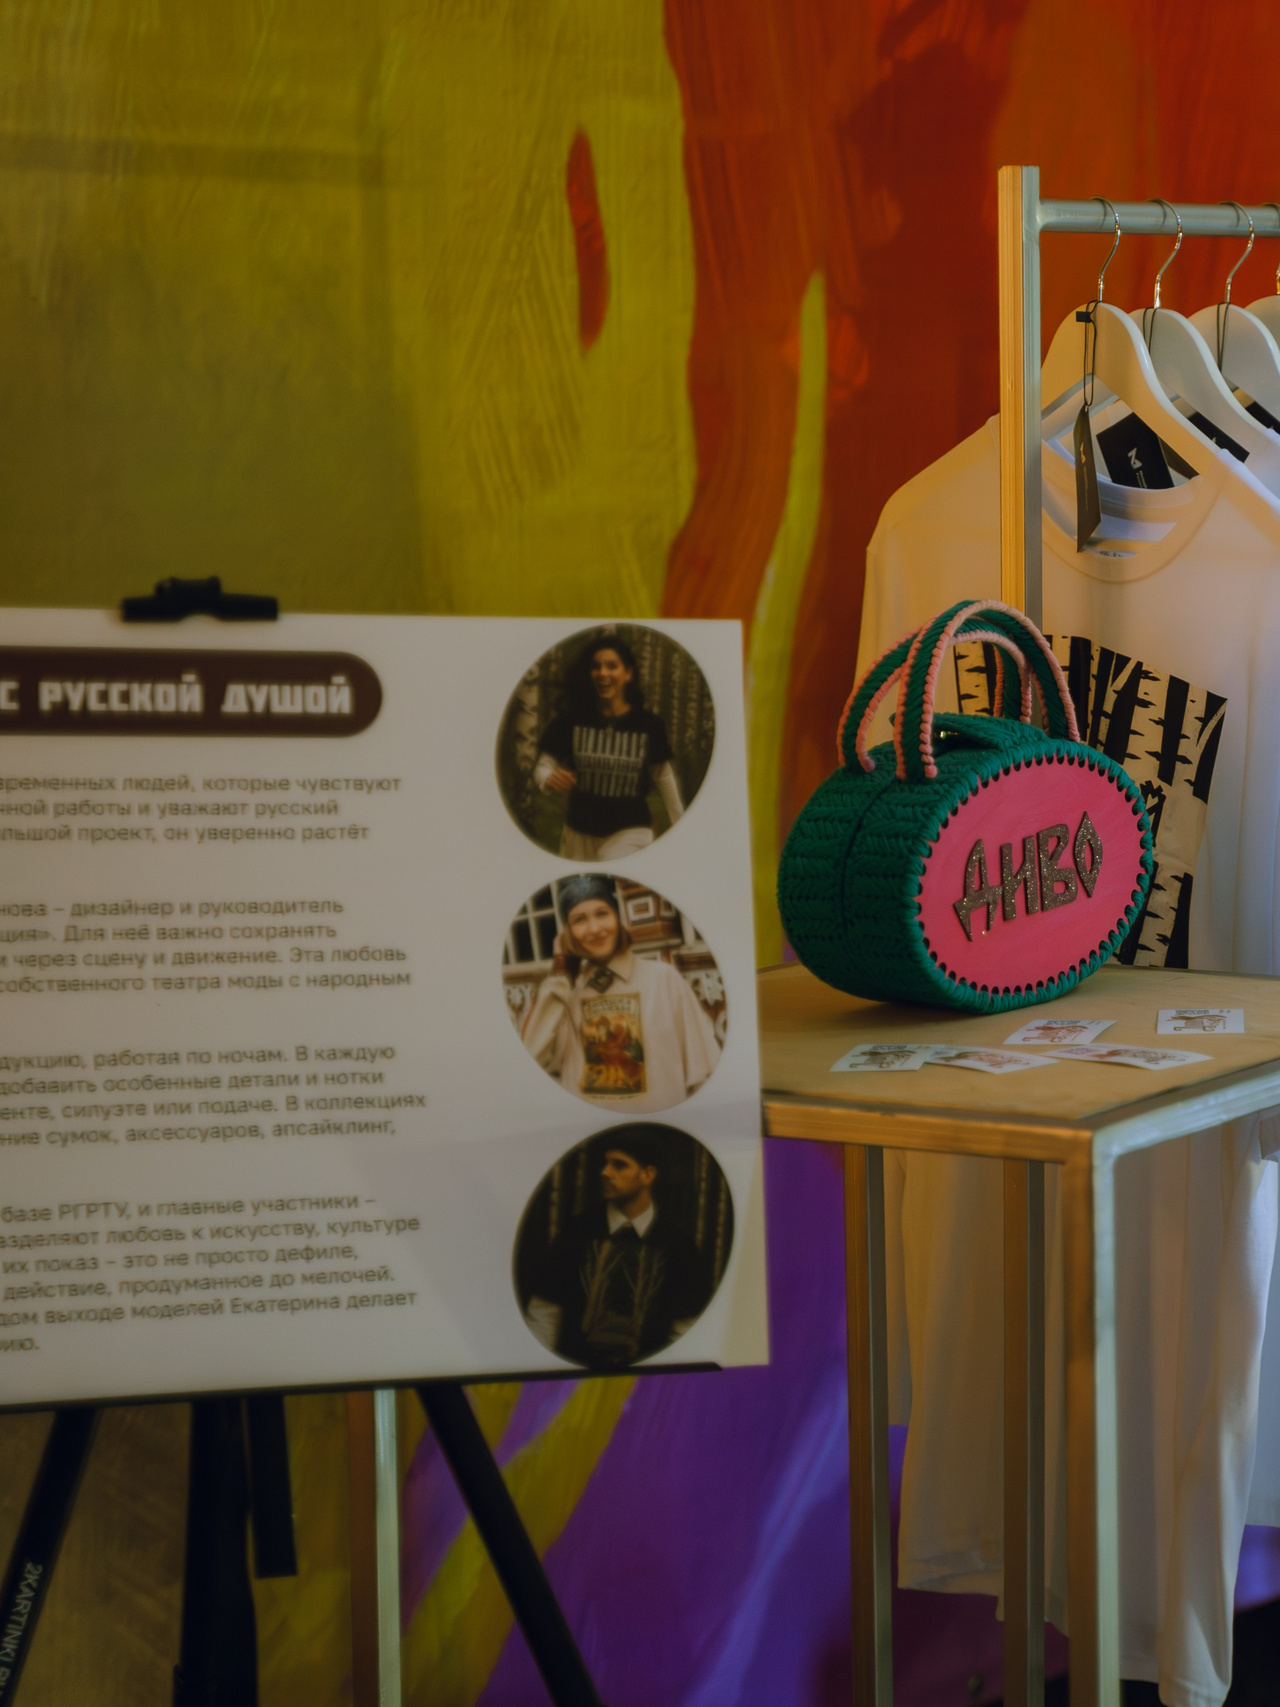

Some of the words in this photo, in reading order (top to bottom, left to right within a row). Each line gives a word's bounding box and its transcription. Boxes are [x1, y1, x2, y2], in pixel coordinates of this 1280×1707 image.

[38, 671, 204, 713] РУССКОЙ
[221, 674, 352, 714] ДУШОЙ
[122, 775, 196, 793] людей,
[202, 778, 291, 793] которые
[296, 778, 400, 793] чувствуют
[52, 800, 132, 818] работы
[137, 803, 151, 814] и
[157, 803, 248, 818] уважают
[254, 800, 339, 818] русский
[0, 825, 72, 840] льшой
[77, 828, 158, 843] проект,
[163, 828, 190, 839] он
[195, 827, 296, 842] уверенно
[300, 824, 369, 842] растёт
[953, 811, 1103, 941] ДИВО
[70, 899, 174, 918] дизайнер
[178, 902, 193, 914] и
[197, 900, 344, 917] руководитель
[63, 925, 107, 940] Для
[111, 924, 150, 940] неё
[156, 927, 224, 939] важно
[228, 925, 336, 941] сохранять
[13, 954, 77, 970] через
[82, 953, 147, 969] сцену
[152, 952, 166, 964] и
[171, 950, 283, 967] движение.
[289, 946, 326, 962] Эта
[330, 945, 406, 961] любовь
[152, 976, 222, 992] театра
[227, 975, 284, 990] моды
[288, 975, 300, 987] с
[305, 973, 411, 990] народным
[92, 1049, 181, 1069] работая
[186, 1051, 212, 1064] по
[217, 1049, 288, 1063] ночам.
[294, 1046, 310, 1061] В
[314, 1047, 396, 1064] каждую
[102, 1074, 222, 1091] особенные
[227, 1074, 300, 1090] детали
[304, 1073, 319, 1085] и
[323, 1071, 384, 1084] нотки
[60, 1103, 147, 1120] силуэте
[152, 1102, 193, 1114] или
[198, 1099, 280, 1116] подаче.
[284, 1095, 300, 1110] В
[304, 1095, 426, 1111] коллекциях
[45, 1130, 118, 1146] сумок,
[125, 1124, 266, 1144] аксессуаров,
[272, 1118, 397, 1138] апсайклинг,
[0, 1205, 52, 1222] базе
[58, 1202, 133, 1221] РГРТУ,
[136, 1204, 152, 1216] и
[156, 1200, 245, 1215] главные
[250, 1195, 360, 1215] участники
[105, 1226, 186, 1243] любовь
[191, 1227, 204, 1239] к
[208, 1222, 320, 1242] искусству,
[326, 1218, 420, 1237] культуре
[2, 1261, 28, 1273] их
[34, 1257, 100, 1272] показ
[122, 1254, 158, 1268] это
[162, 1253, 190, 1266] не
[194, 1249, 269, 1267] просто
[274, 1244, 359, 1264] дефиле,
[3, 1280, 112, 1302] действие,
[118, 1275, 264, 1296] продуманное
[269, 1273, 295, 1289] до
[300, 1265, 396, 1284] мелочей.
[44, 1307, 125, 1324] выходе
[130, 1299, 224, 1320] моделей
[229, 1295, 341, 1315] Екатерина
[346, 1292, 416, 1311] делает
